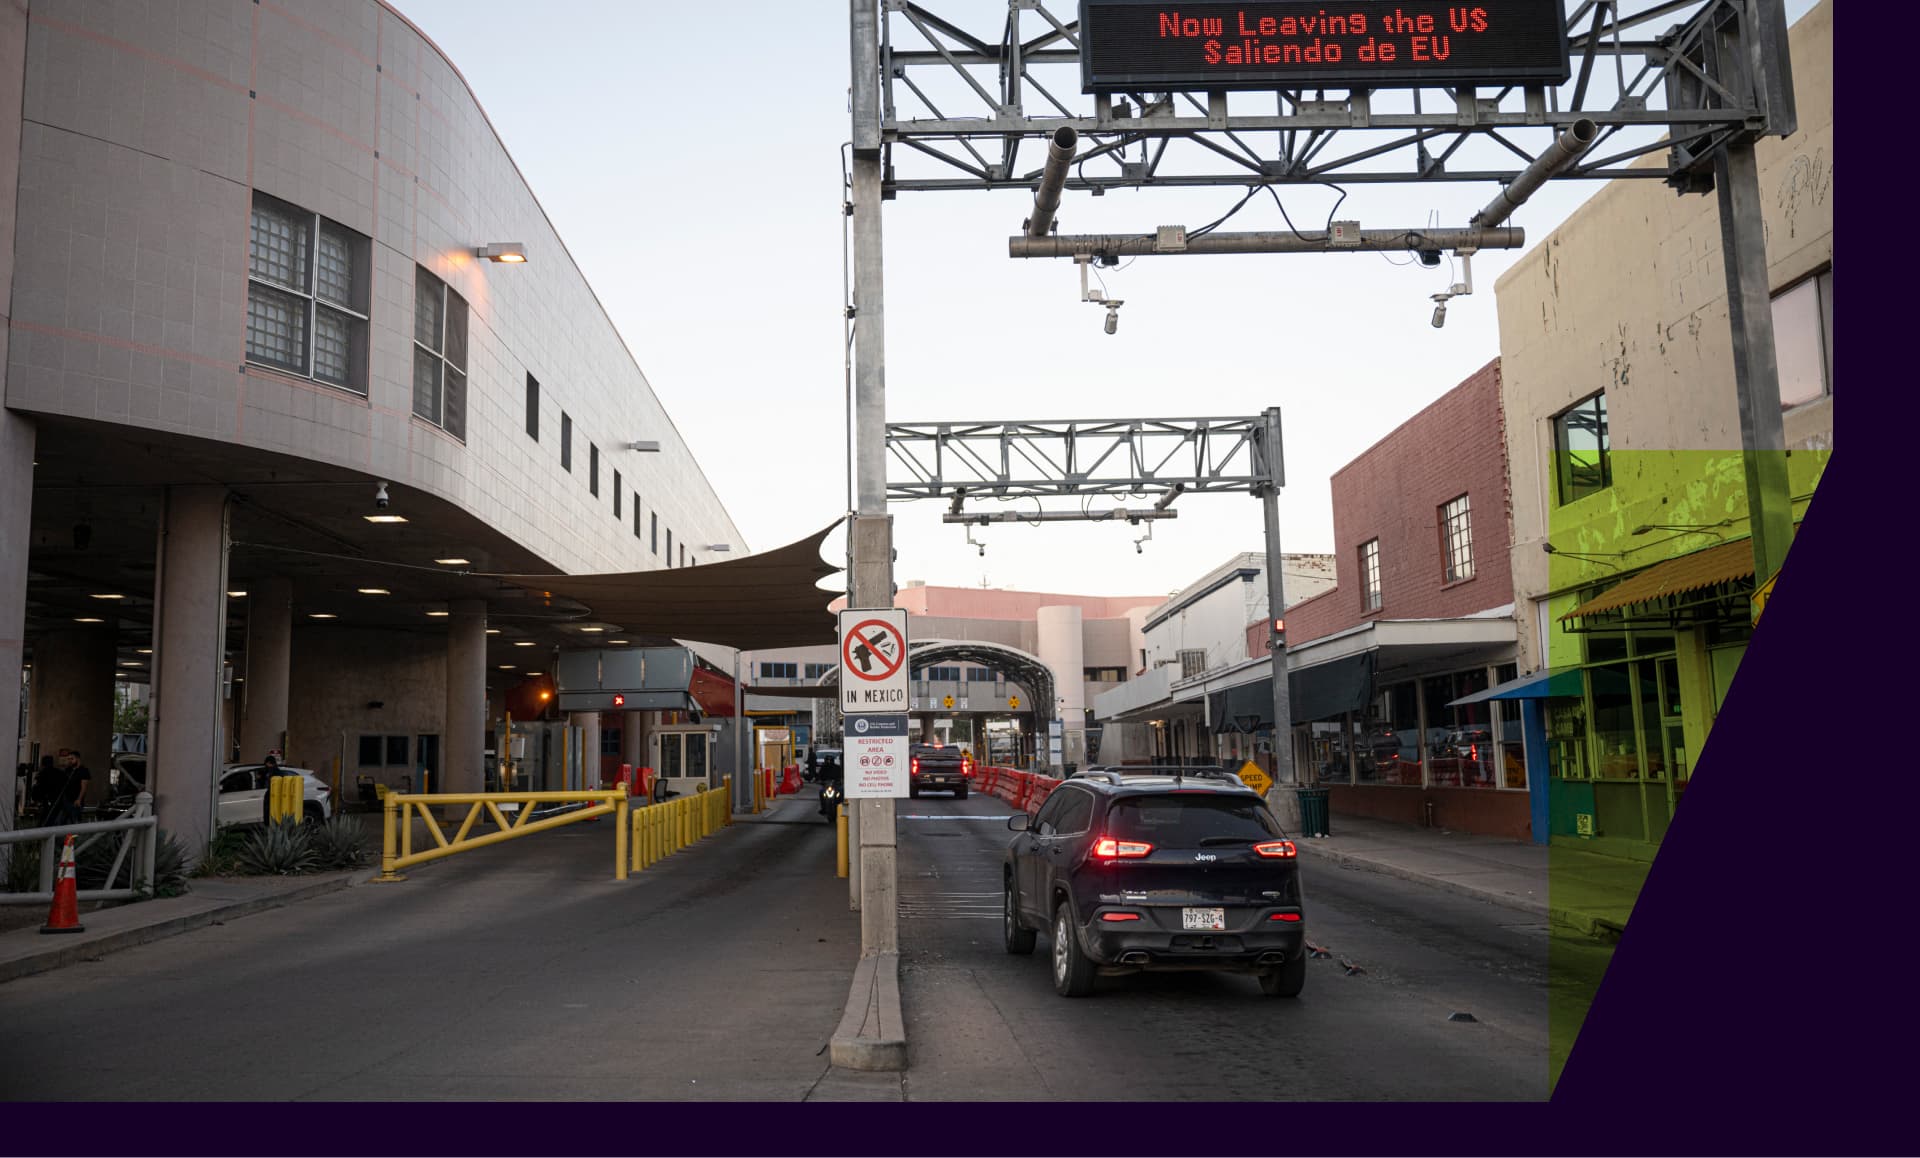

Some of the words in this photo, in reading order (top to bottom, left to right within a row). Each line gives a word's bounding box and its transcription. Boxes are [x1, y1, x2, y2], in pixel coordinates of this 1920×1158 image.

[1159, 12, 1223, 37] Now
[1239, 10, 1367, 36] Leaving
[1383, 8, 1434, 33] the
[1450, 7, 1488, 32] US
[1204, 37, 1342, 64] Saliendo
[1358, 37, 1397, 62] de
[847, 690, 857, 703] IN
[865, 689, 903, 702] MEXICO
[1195, 852, 1216, 861] Jeep
